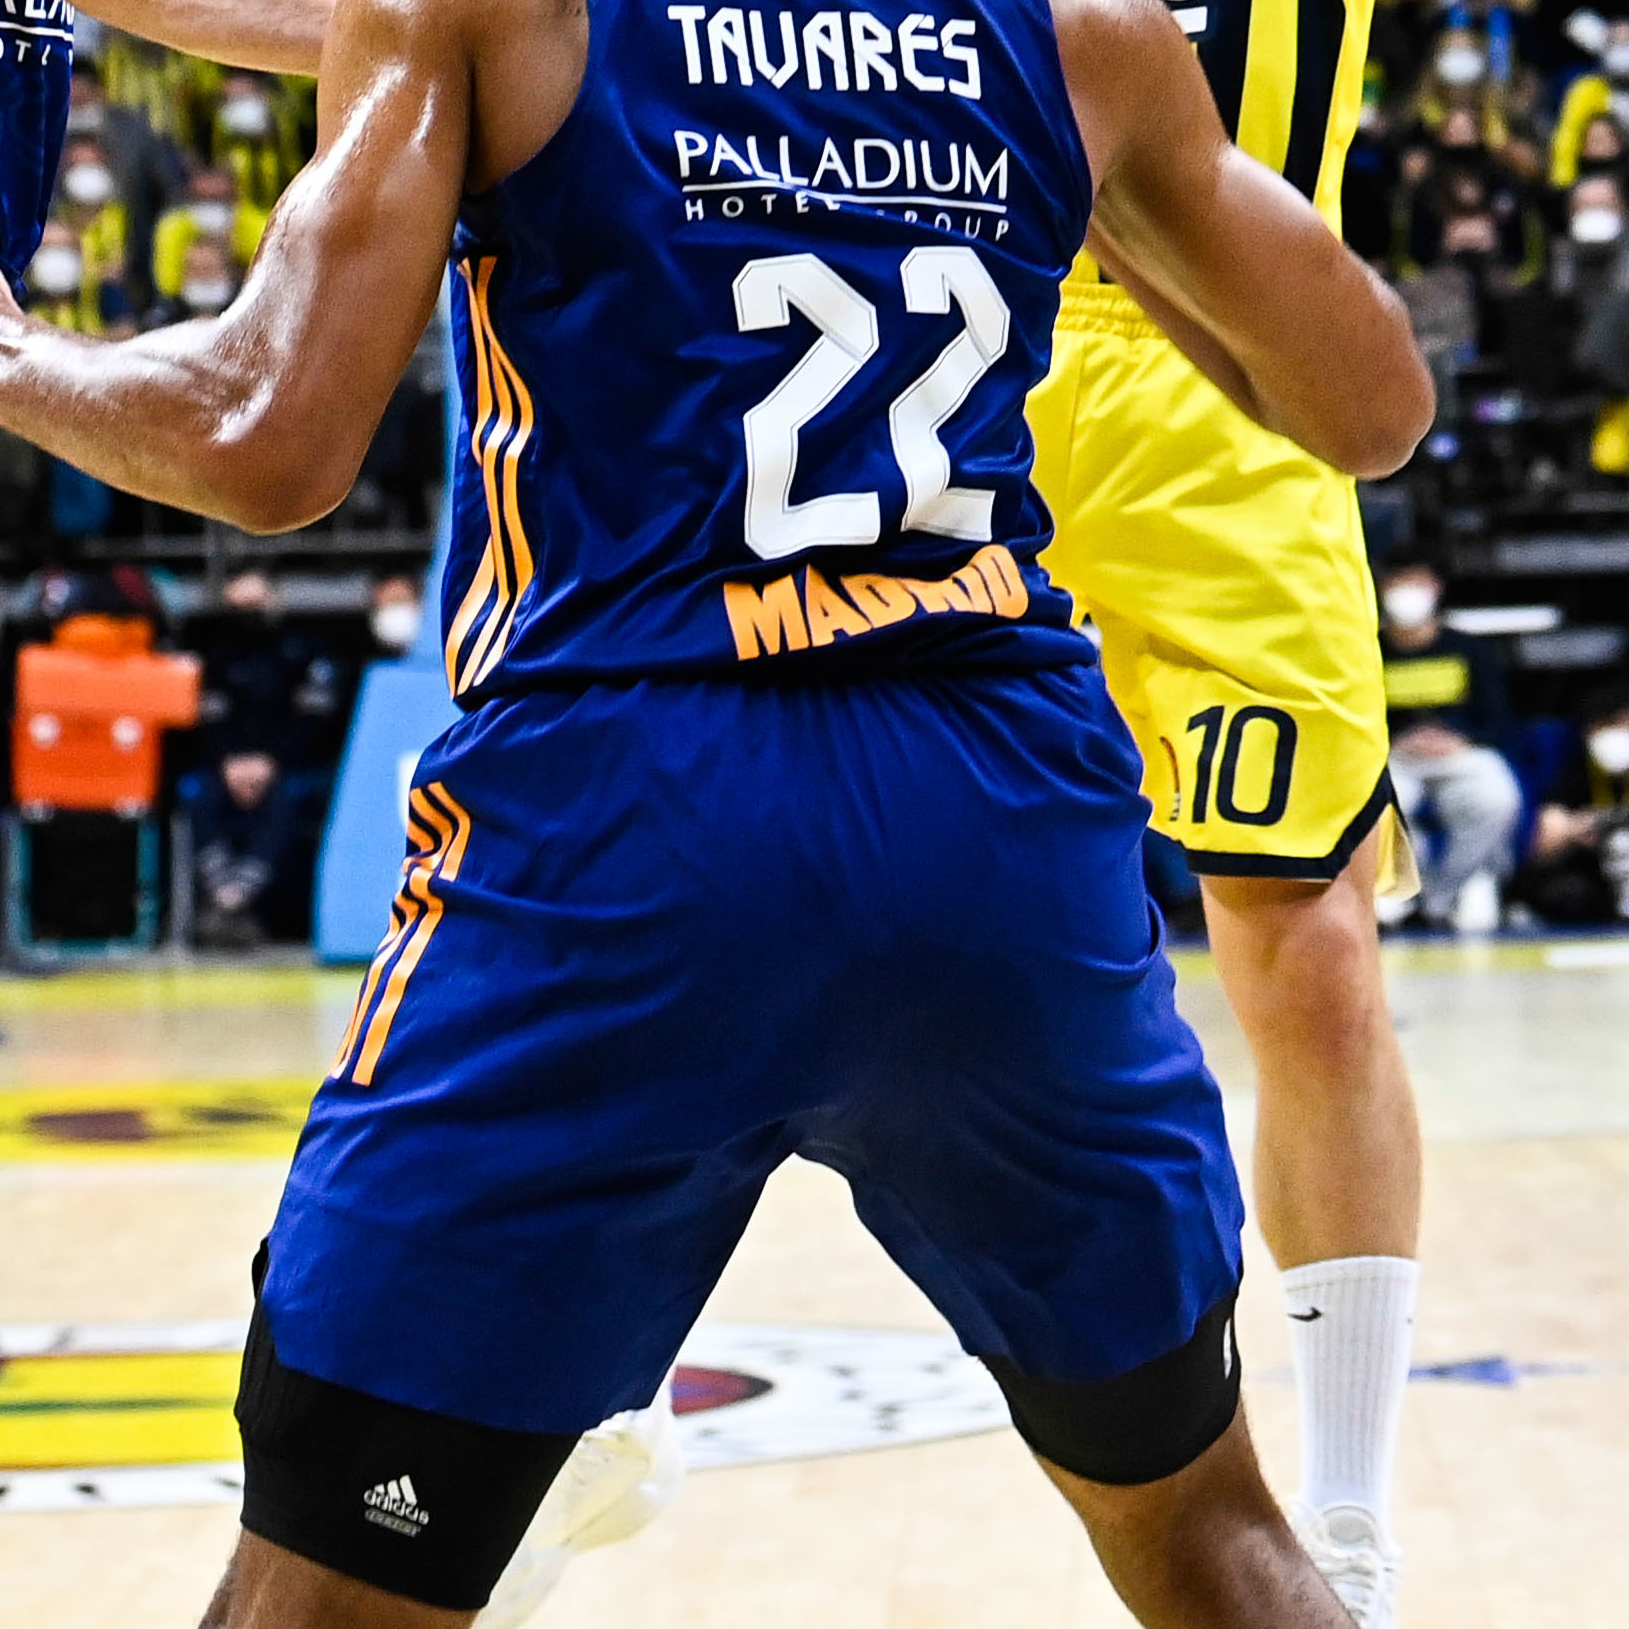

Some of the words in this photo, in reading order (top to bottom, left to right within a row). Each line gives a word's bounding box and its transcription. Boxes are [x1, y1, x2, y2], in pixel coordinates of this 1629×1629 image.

[668, 5, 982, 100] TAVARES
[674, 129, 1008, 200] PALLADIUM
[732, 246, 1011, 559] 22
[723, 545, 1030, 661] MADRID
[1186, 705, 1298, 827] 10
[363, 1488, 430, 1525] adidas
